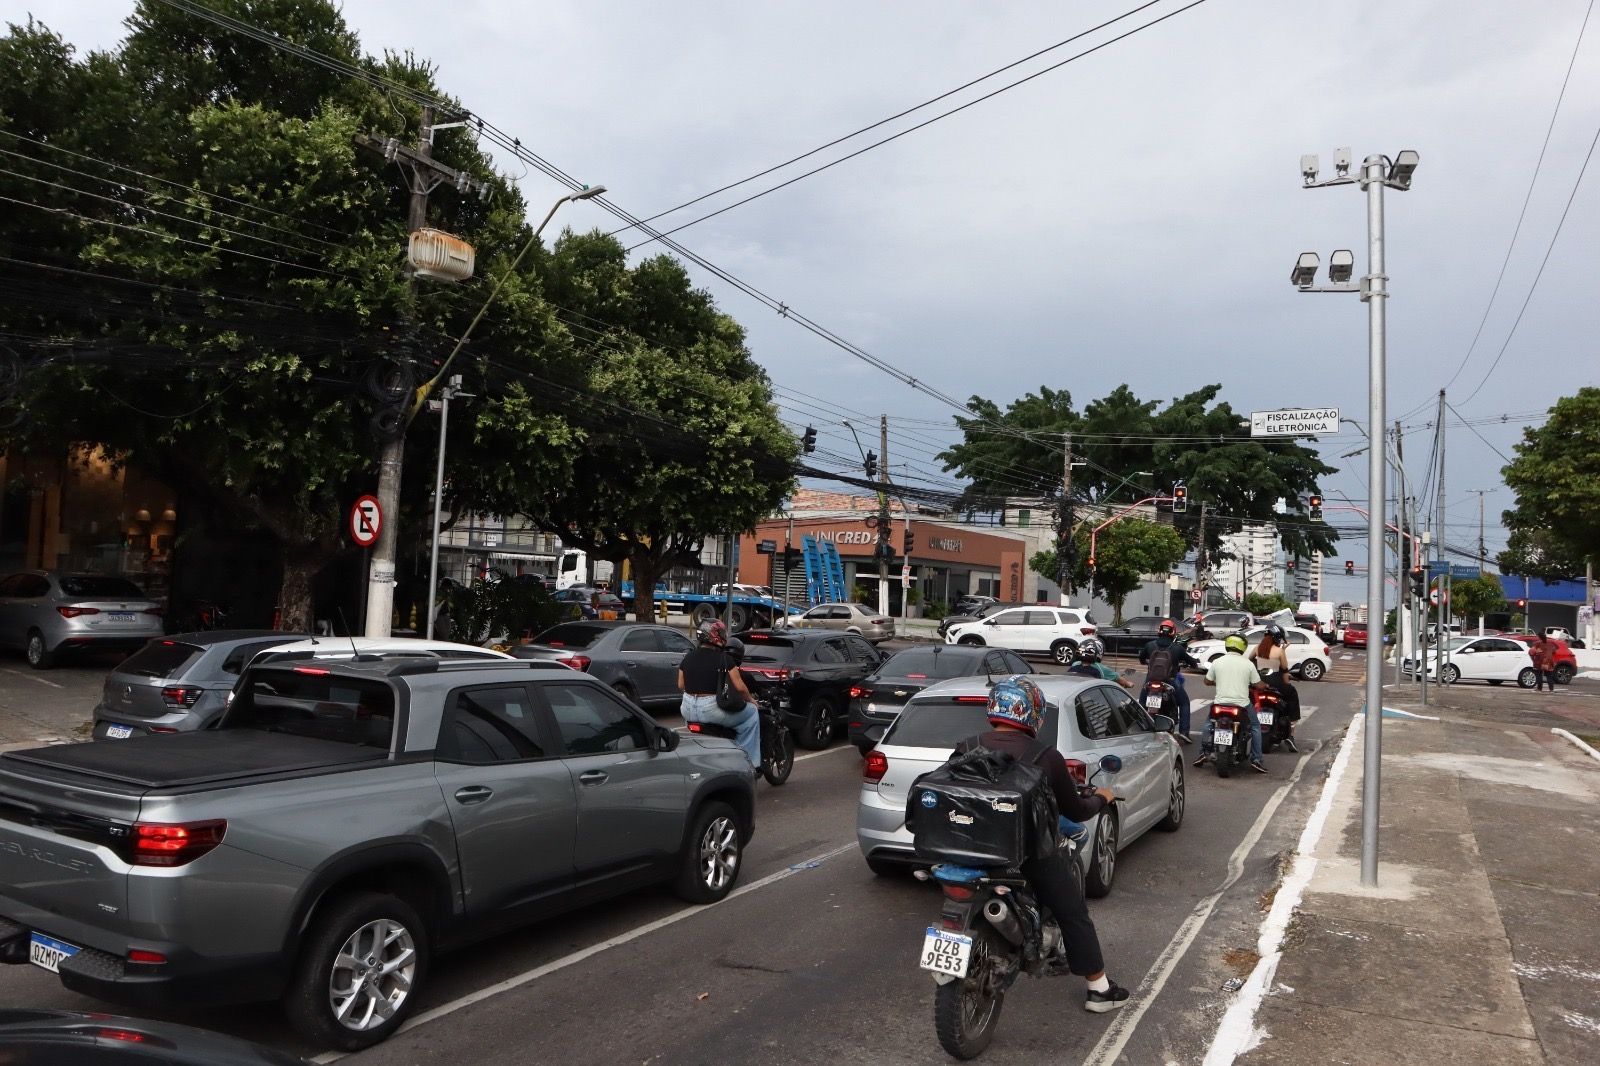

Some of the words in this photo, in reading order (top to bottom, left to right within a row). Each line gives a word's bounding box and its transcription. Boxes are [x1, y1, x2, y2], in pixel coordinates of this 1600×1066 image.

[1267, 410, 1337, 421] FISCALIZAÇÃO
[1266, 423, 1328, 433] ELETRÔNICA
[933, 938, 960, 957] QZB
[926, 951, 963, 973] 9E53
